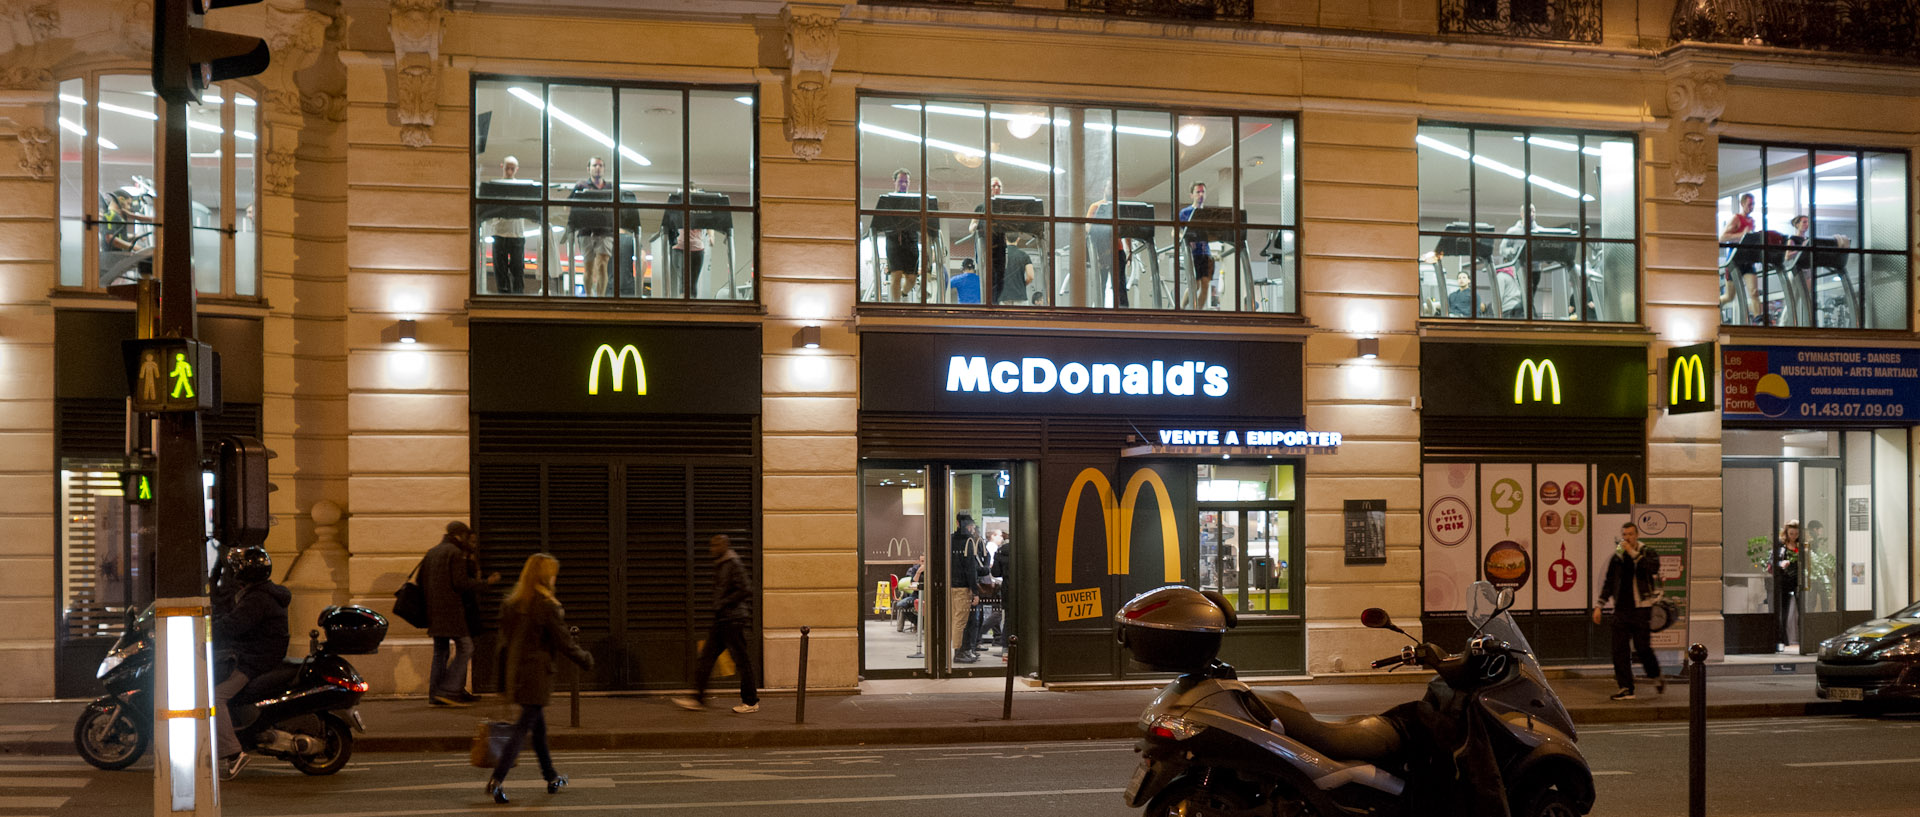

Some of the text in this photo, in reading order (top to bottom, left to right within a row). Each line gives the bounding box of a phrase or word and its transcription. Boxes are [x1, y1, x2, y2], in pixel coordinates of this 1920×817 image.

[1725, 355, 1742, 365] Les
[1797, 352, 1861, 363] GYMNASTIQUE
[1867, 353, 1901, 363] DANSES
[945, 355, 1230, 397] McDonald's
[1725, 369, 1760, 380] Cercles
[1781, 366, 1843, 376] MUSCULATION
[1850, 367, 1873, 377] ARTS
[1874, 367, 1918, 378] MARTIAUX
[1725, 384, 1748, 394] de la
[1811, 387, 1832, 395] COURS
[1833, 387, 1860, 396] ADULTES
[1867, 388, 1893, 396] ENFANTS
[1725, 398, 1755, 408] Forme
[1800, 402, 1904, 417] 01.43.07.09.09
[1160, 430, 1342, 446] VENTE A EMPORTER
[1441, 508, 1456, 516] LES
[1435, 514, 1463, 523] P'TITS
[1436, 521, 1465, 532] PRIX
[1060, 590, 1098, 604] OUVERT
[1066, 603, 1094, 618] 7J/7
